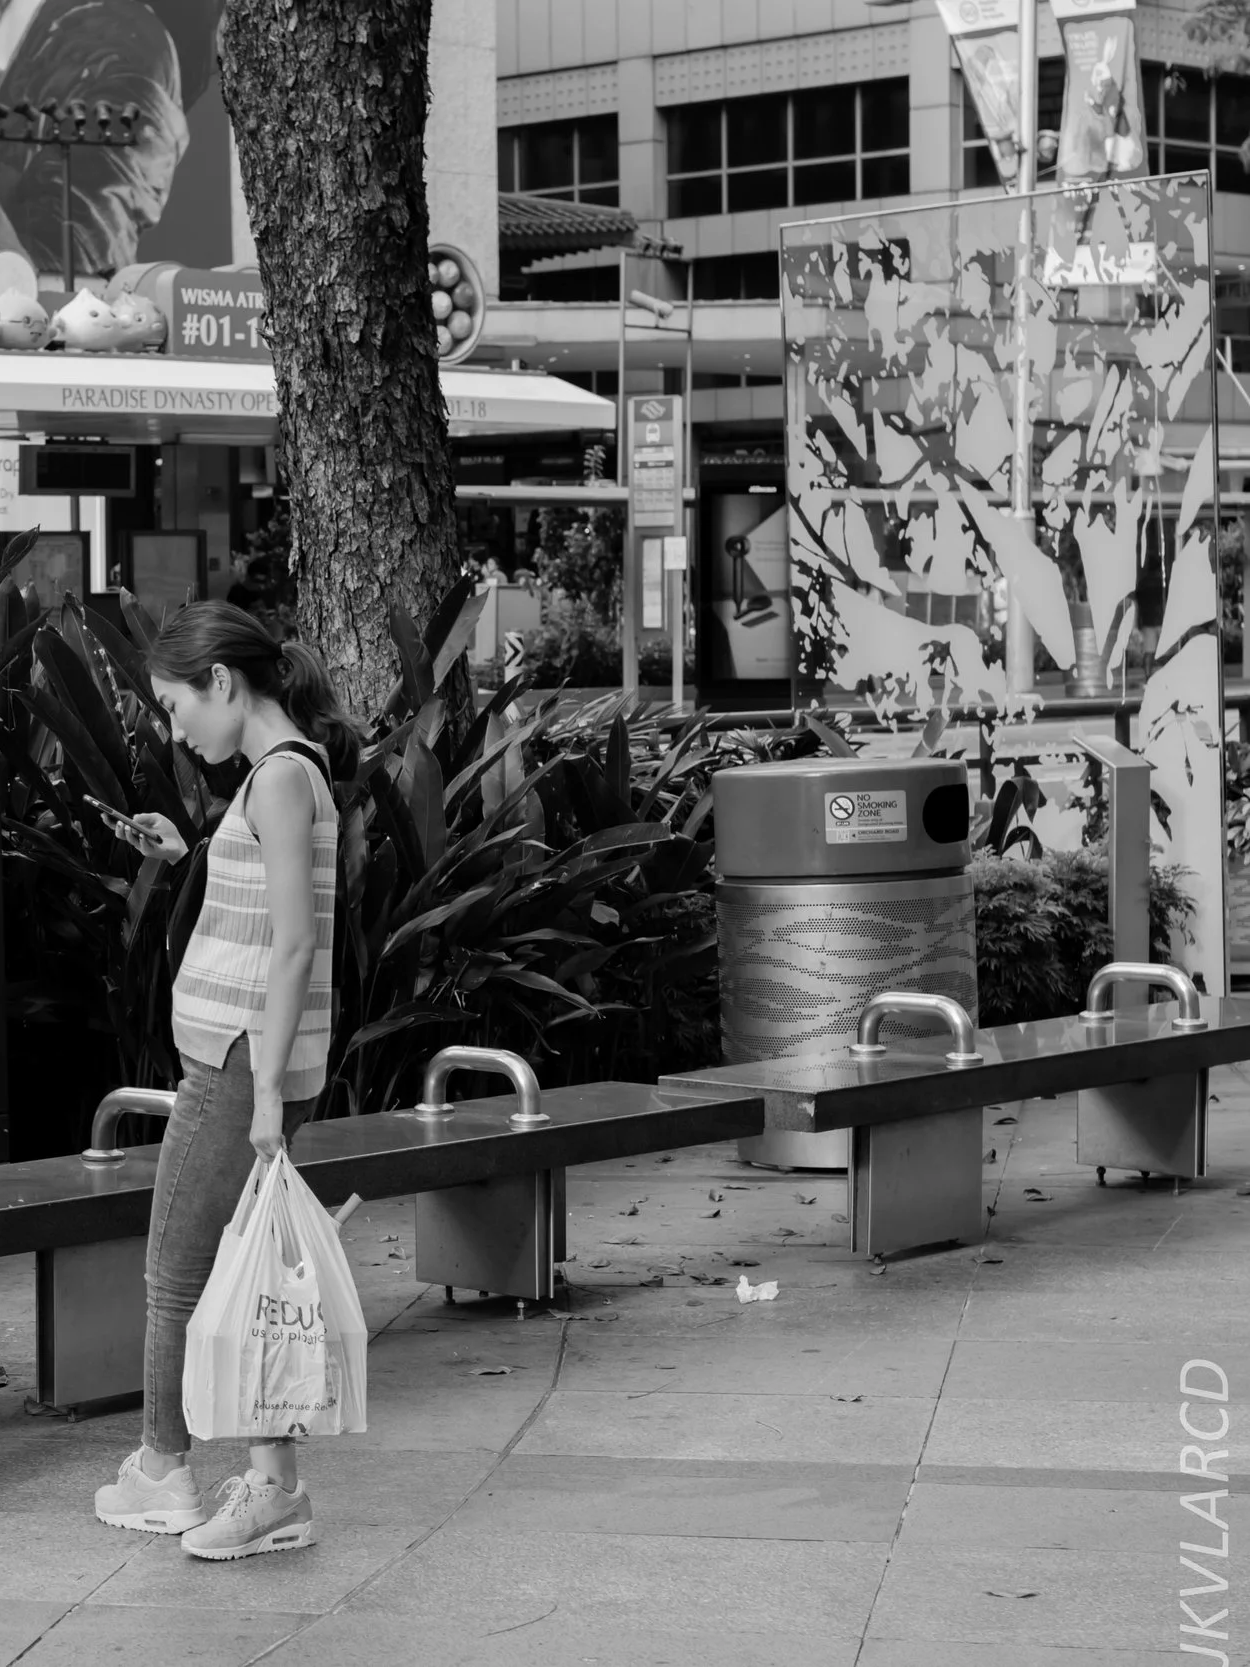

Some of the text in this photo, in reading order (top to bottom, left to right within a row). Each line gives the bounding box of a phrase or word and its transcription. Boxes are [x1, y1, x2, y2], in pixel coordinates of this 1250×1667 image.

[180, 288, 235, 308] WISMA
[61, 386, 149, 410] PARADISE
[153, 388, 236, 412] DYNASTY
[856, 793, 871, 802] NO
[857, 800, 898, 810] SMOKING
[857, 809, 882, 818] ZONE
